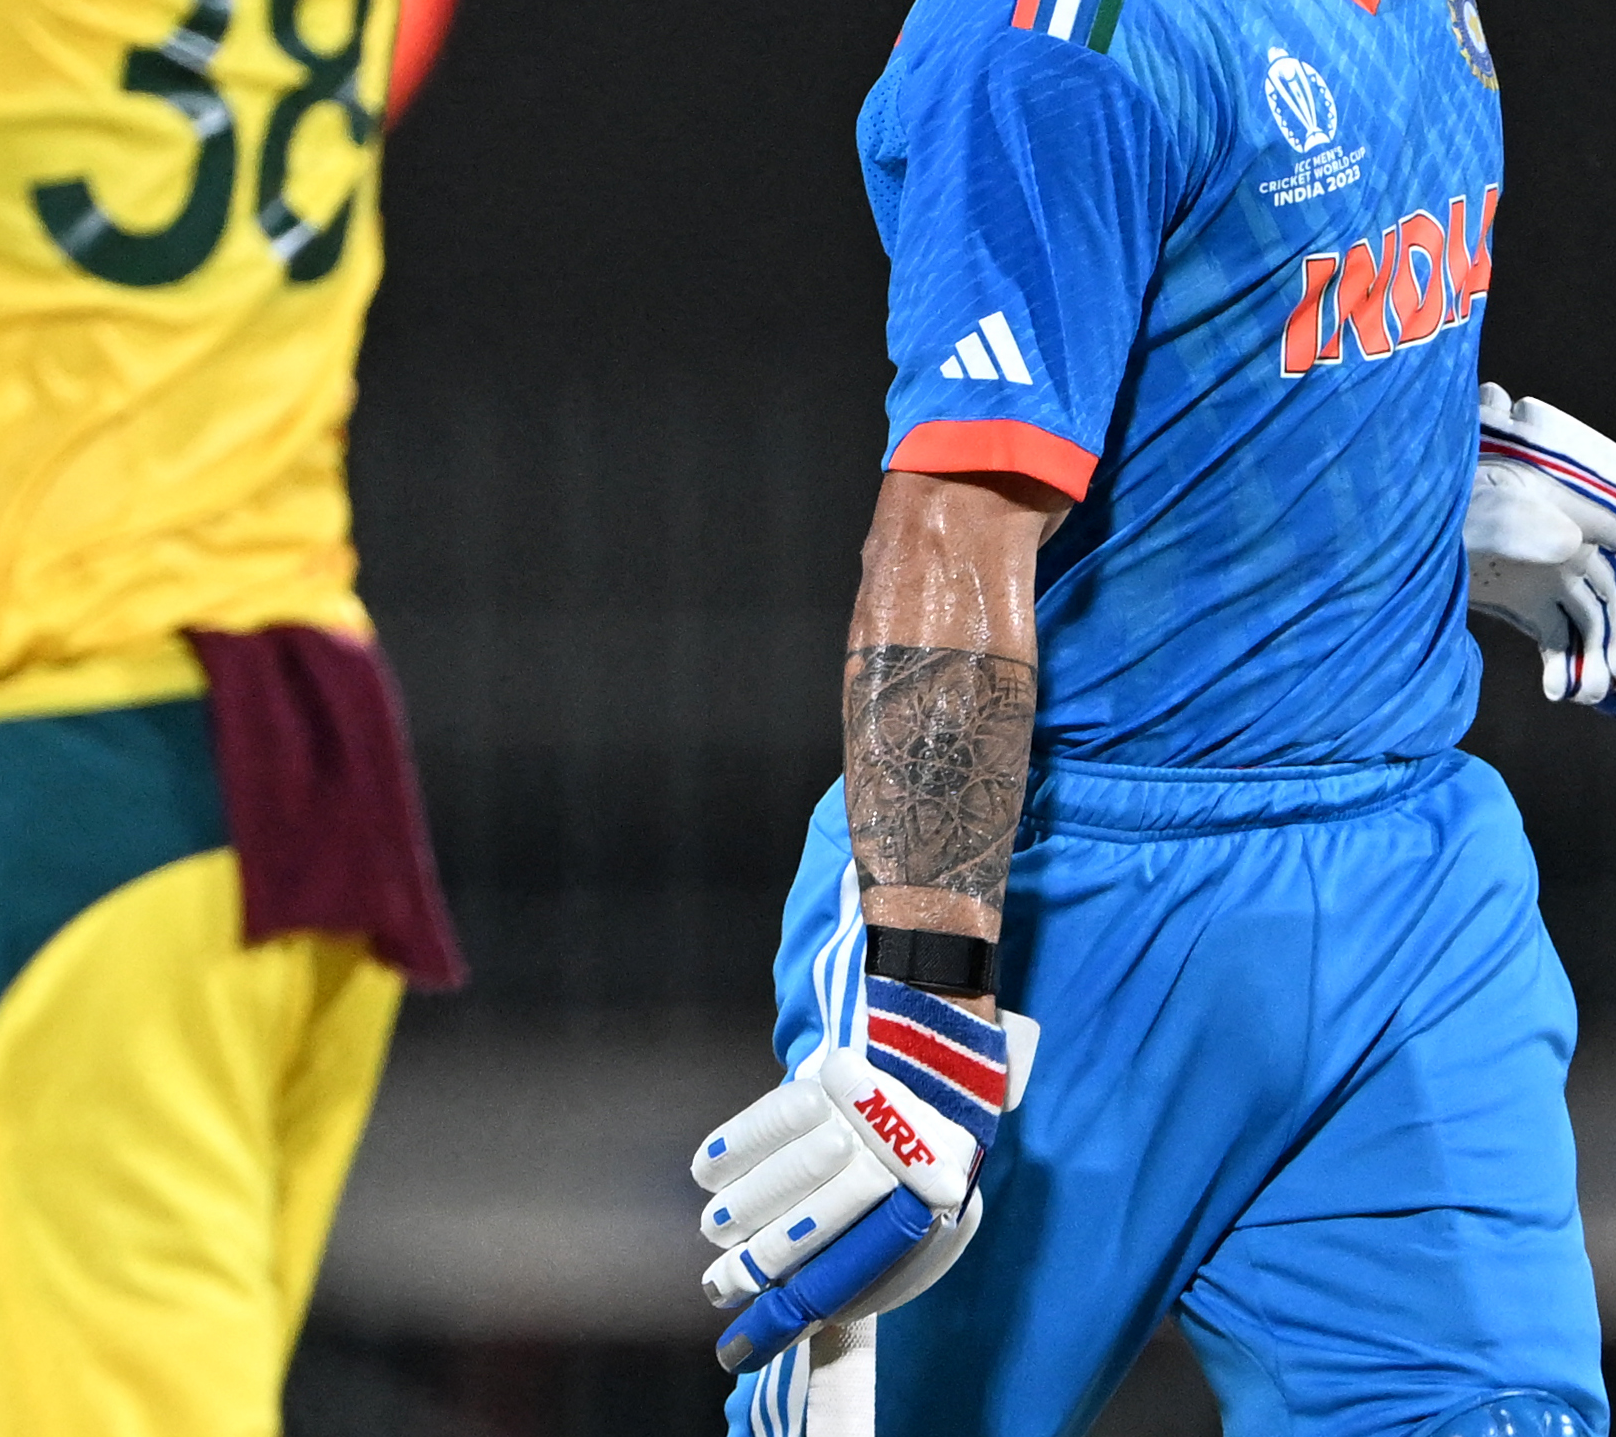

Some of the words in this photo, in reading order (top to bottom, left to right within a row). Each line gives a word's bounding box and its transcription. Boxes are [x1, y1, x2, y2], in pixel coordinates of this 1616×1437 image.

[1259, 171, 1312, 195] CRICKET
[1314, 156, 1350, 180] WORLD
[1349, 146, 1367, 164] CUP
[1294, 158, 1312, 175] ICC
[1313, 145, 1344, 167] MEN'S
[1274, 181, 1326, 207] INDIA
[1326, 165, 1362, 192] 2023
[1280, 182, 1499, 378] INDIA
[853, 1087, 936, 1168] MRF
